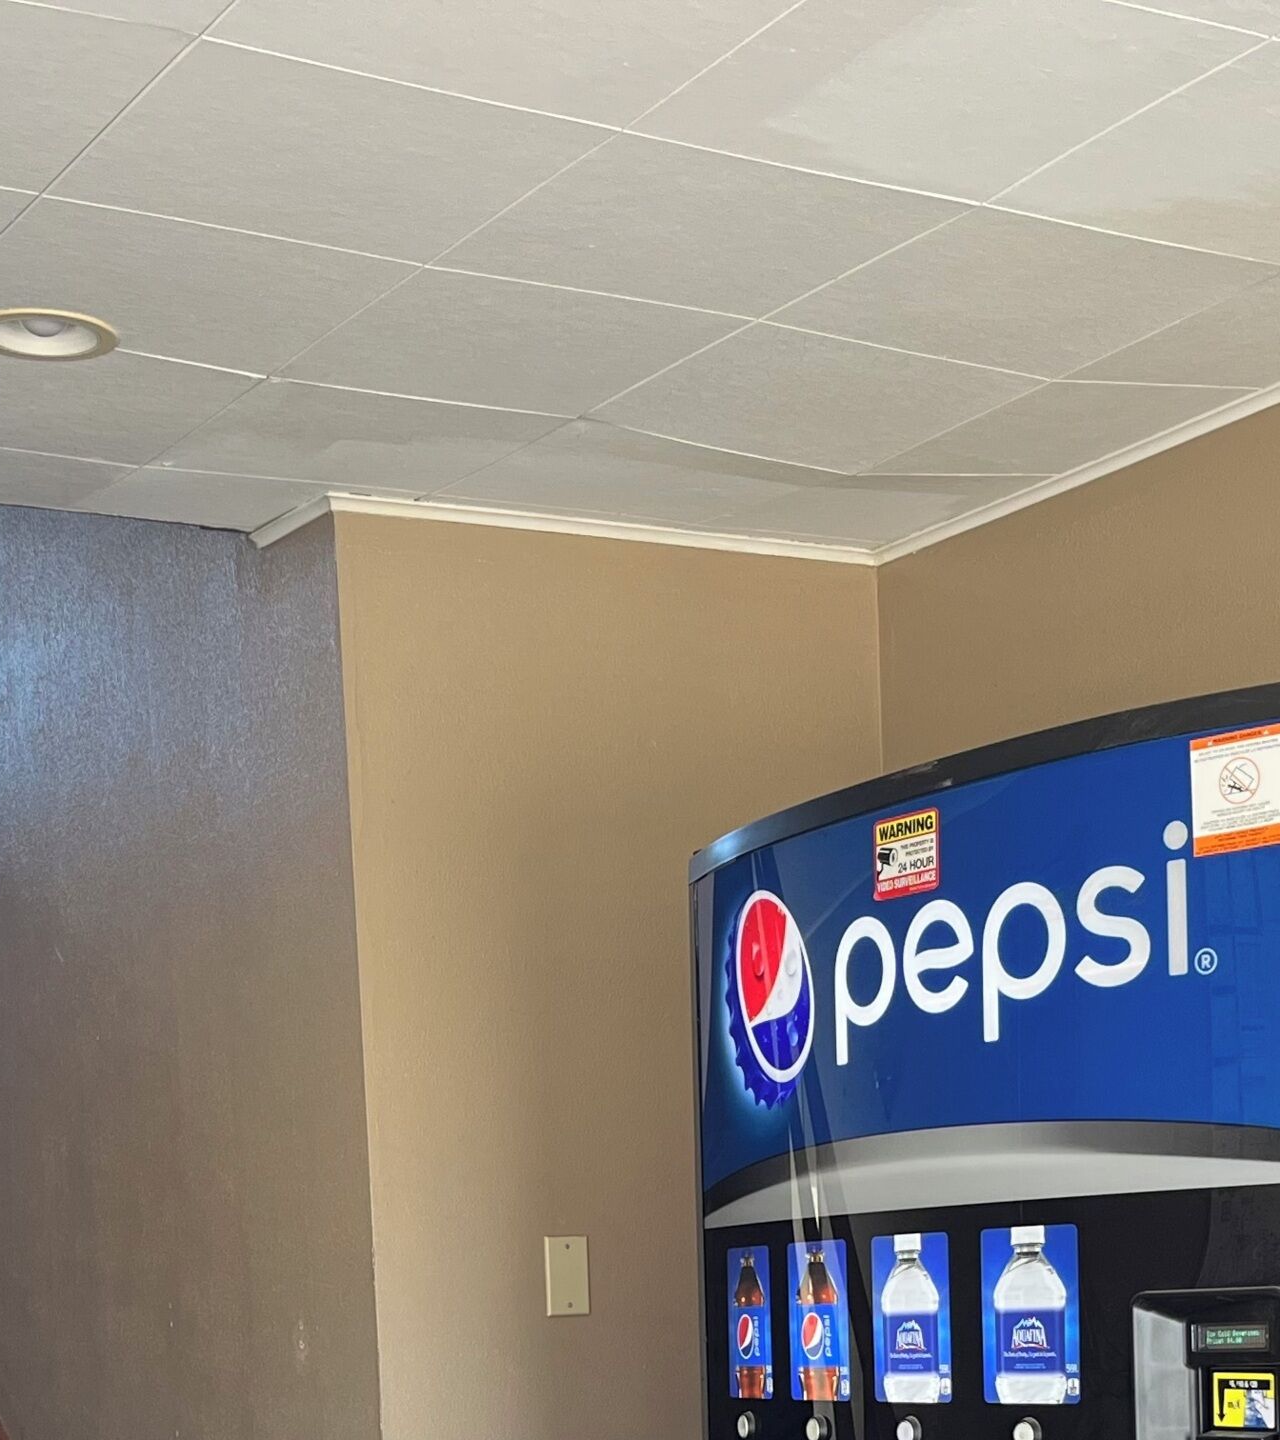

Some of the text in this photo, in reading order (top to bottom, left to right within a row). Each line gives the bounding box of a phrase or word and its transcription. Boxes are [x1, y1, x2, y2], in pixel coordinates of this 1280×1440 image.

[879, 815, 934, 841] WARNING
[898, 856, 934, 873] 24 HOUR
[894, 870, 936, 888] SURVEILLANCE
[835, 820, 1189, 1066] pepsi
[823, 1315, 832, 1357] pepsi
[1011, 1327, 1047, 1349] AQUAFINA
